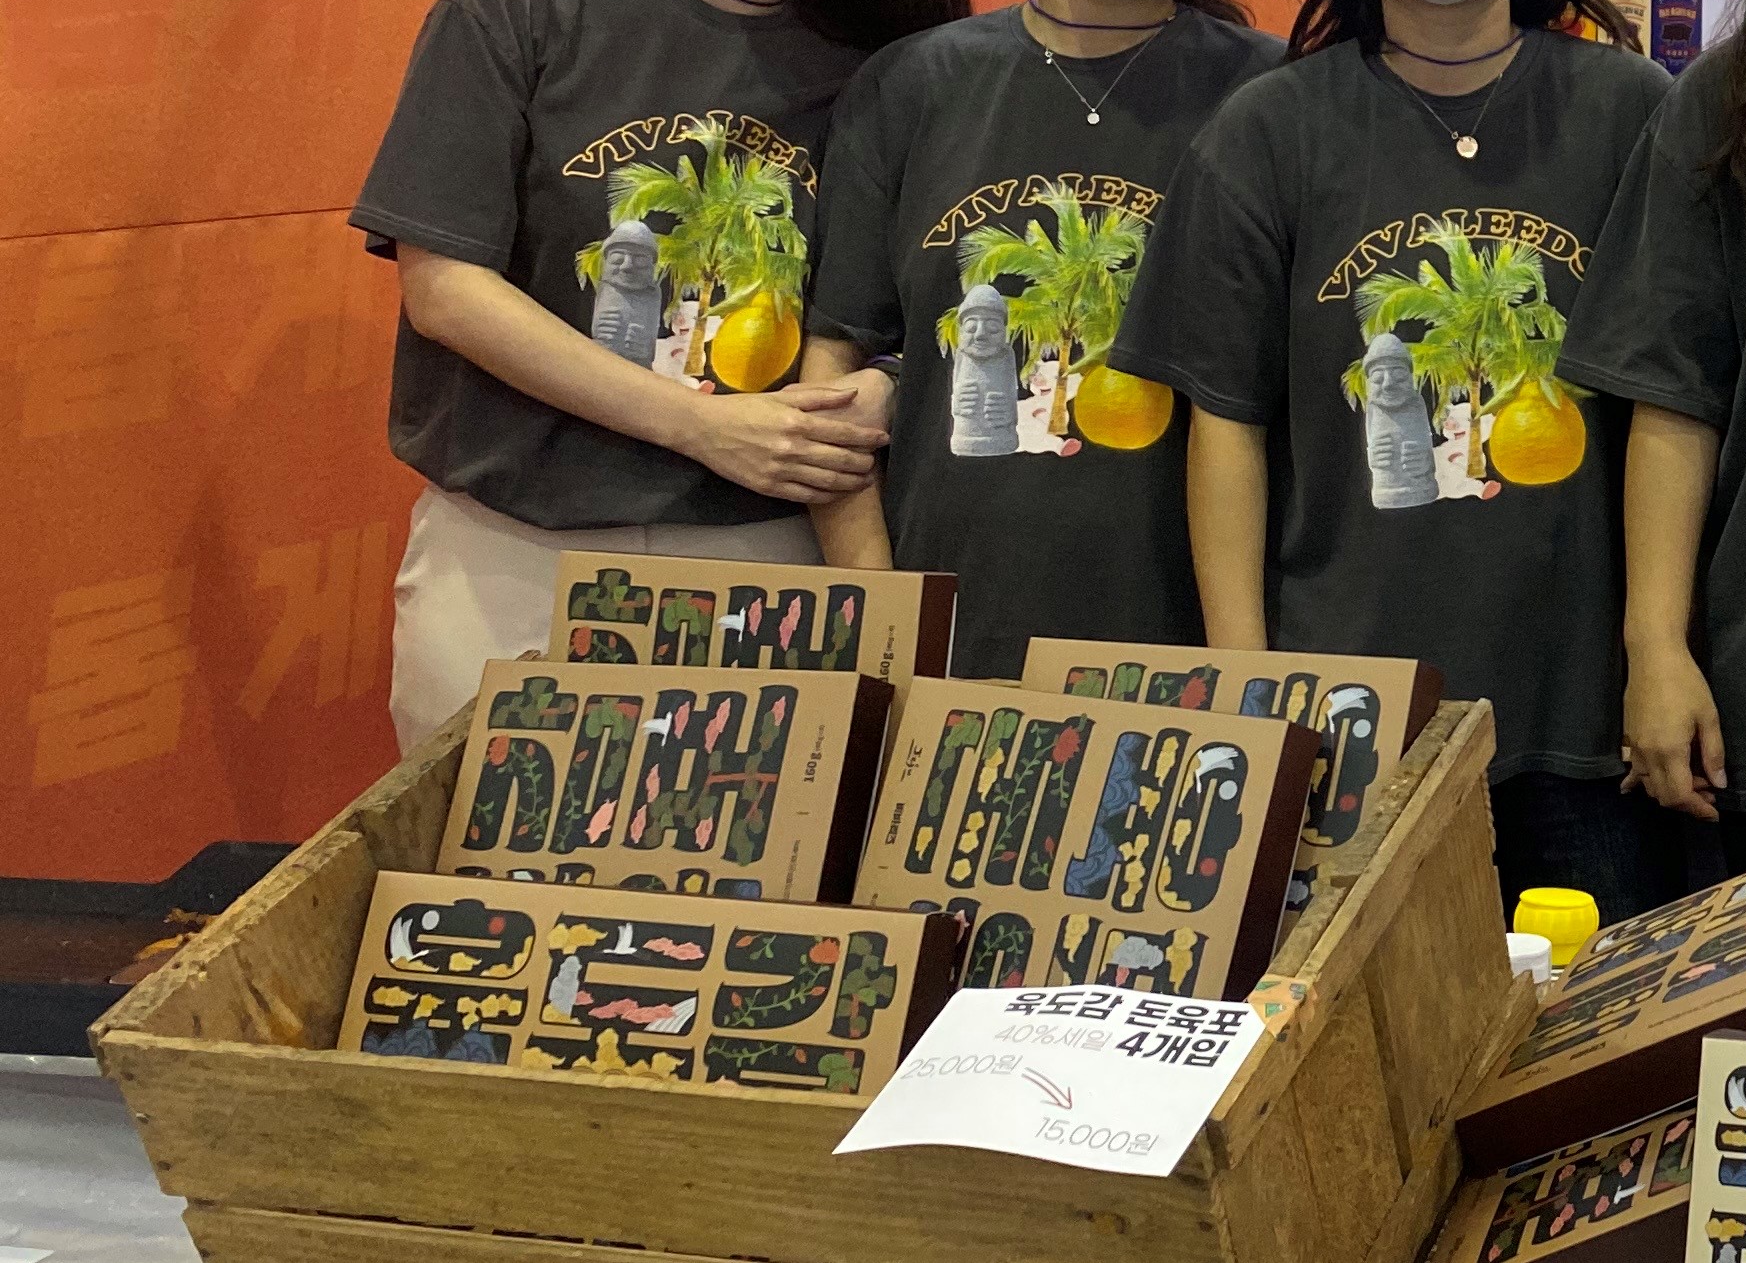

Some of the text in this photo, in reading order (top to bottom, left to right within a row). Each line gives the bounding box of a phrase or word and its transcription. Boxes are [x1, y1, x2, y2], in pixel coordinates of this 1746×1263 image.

[562, 108, 817, 199] VIVALEED
[923, 172, 1166, 249] VIVALEE
[1004, 991, 1250, 1037] 육도감 돈육포
[900, 1054, 1024, 1081] 25,000원
[993, 1023, 1231, 1068] 40%세일 4개입
[1034, 1116, 1160, 1157] 15,000원
